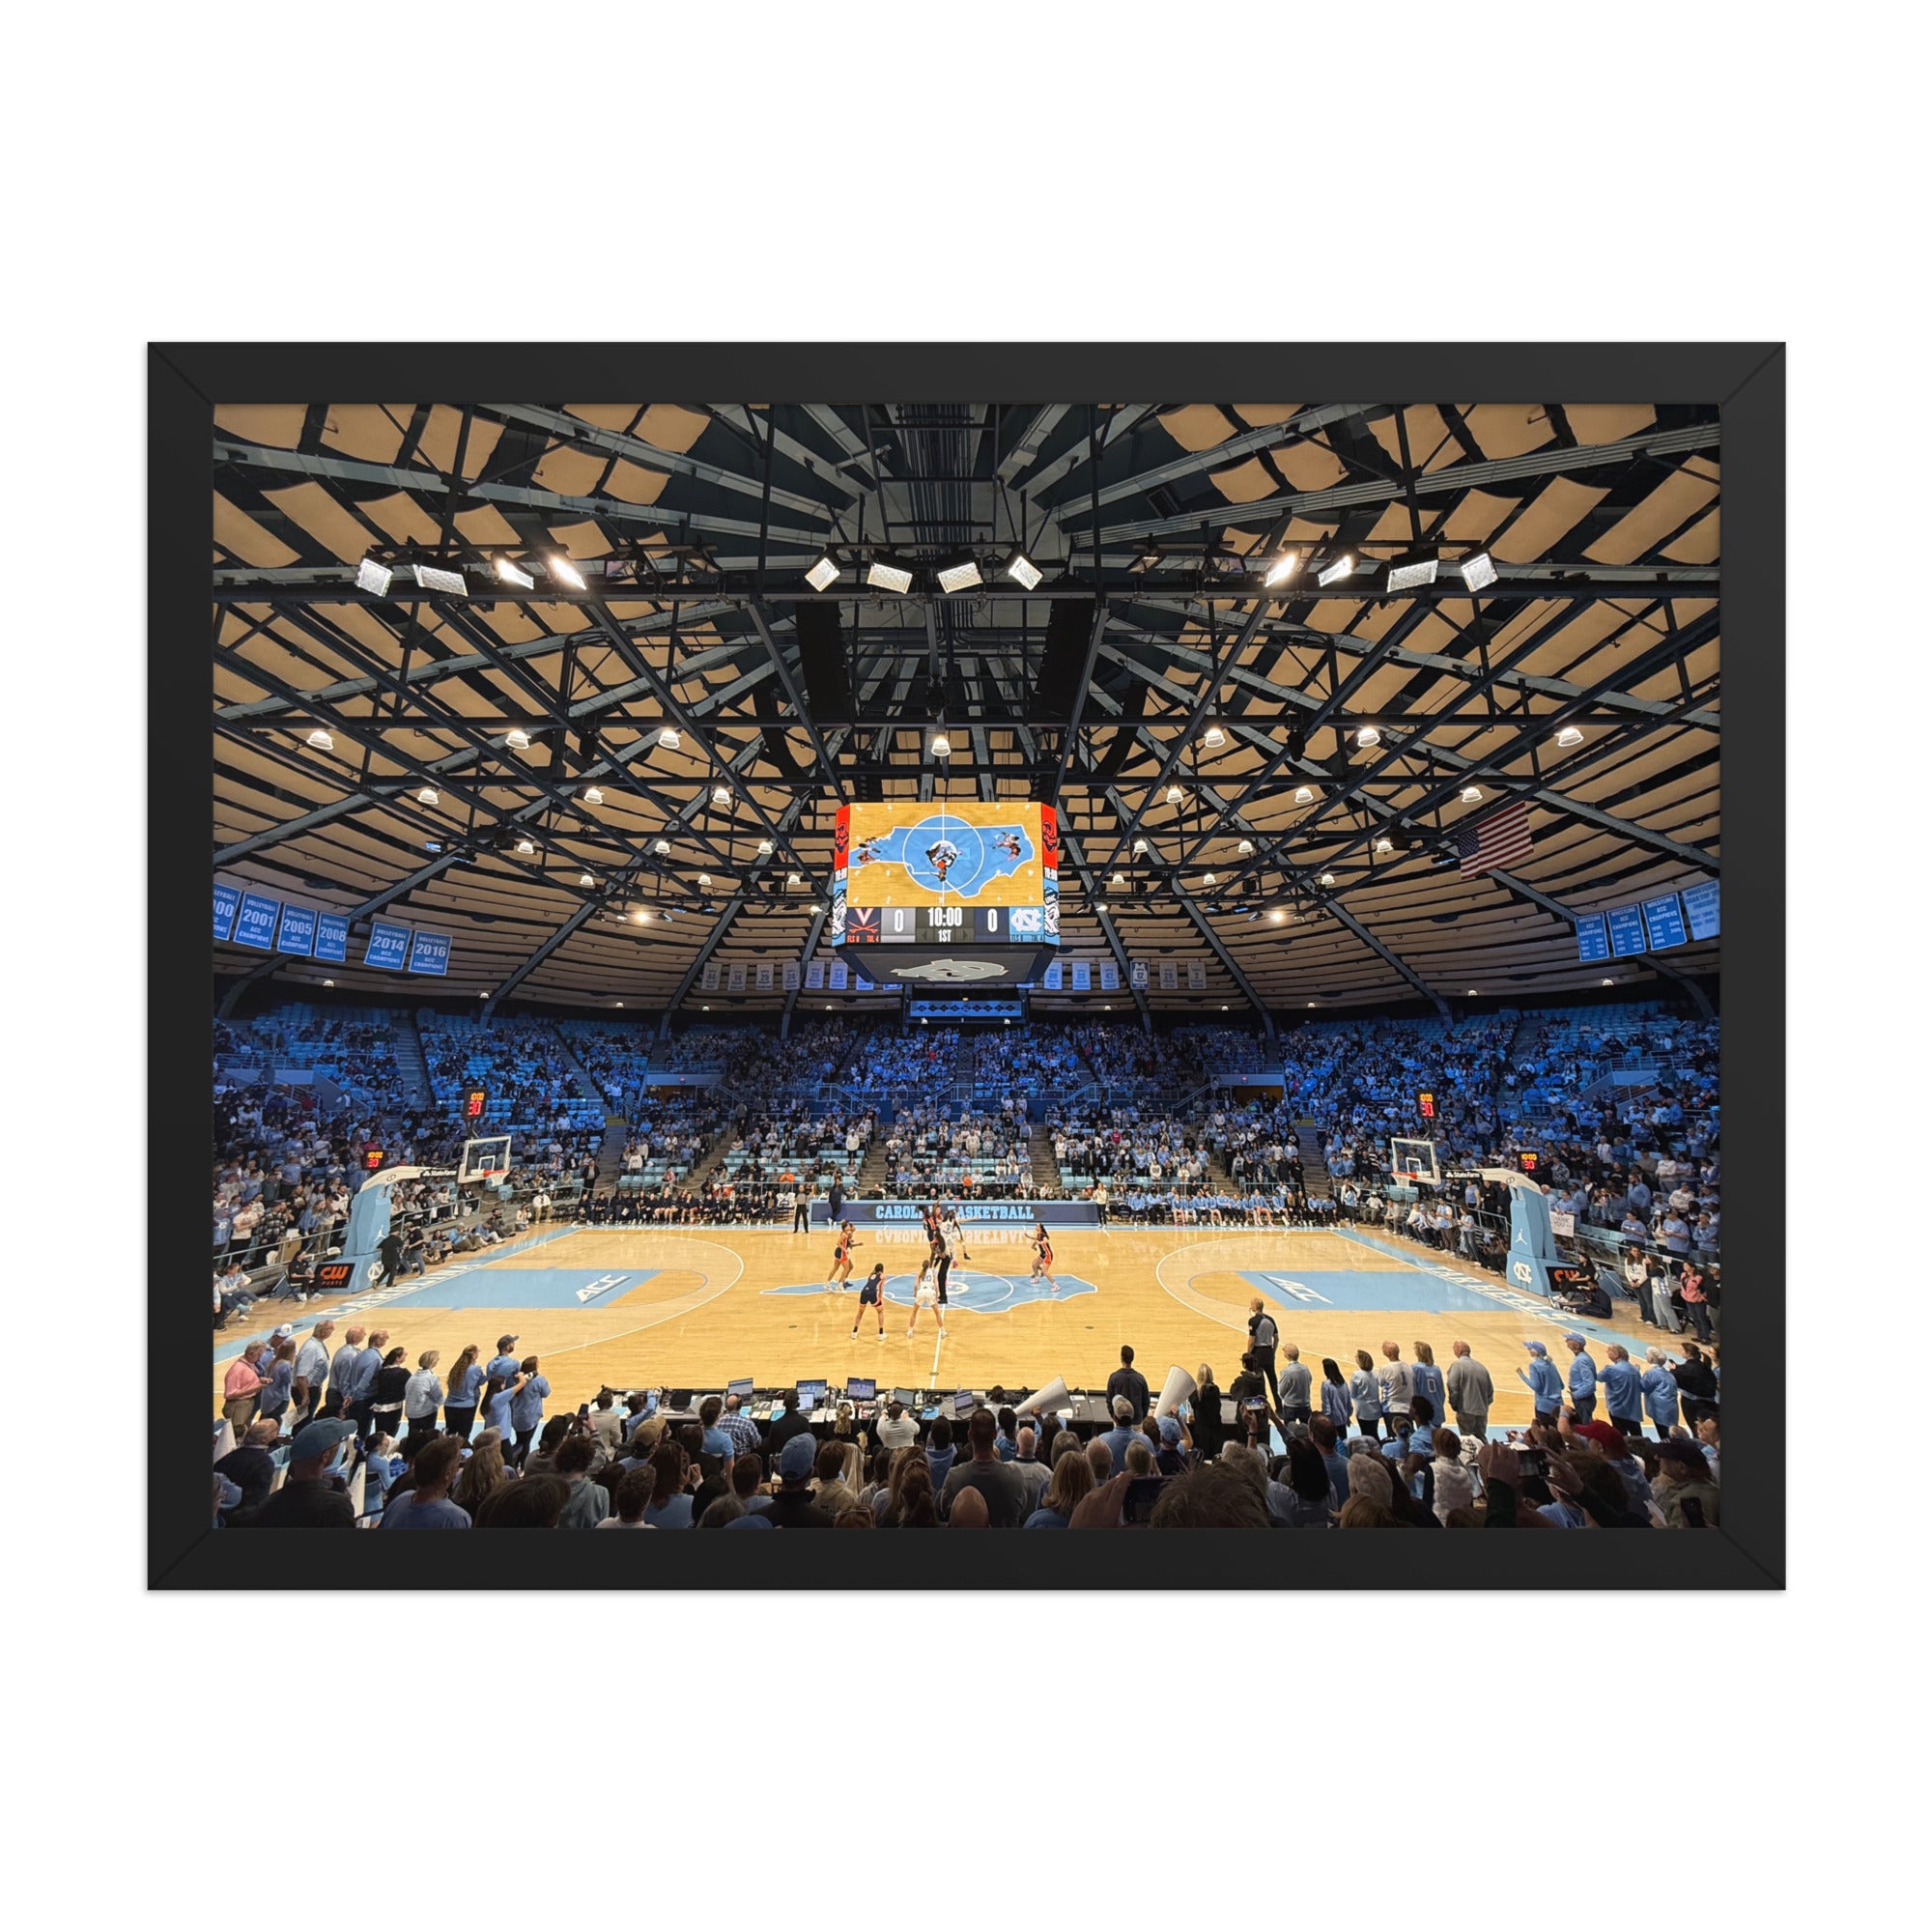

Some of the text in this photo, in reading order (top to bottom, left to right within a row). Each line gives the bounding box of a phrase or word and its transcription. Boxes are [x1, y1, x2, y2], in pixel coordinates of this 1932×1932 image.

[242, 909, 273, 927] 2001
[895, 909, 904, 933] 0
[927, 907, 963, 927] 10:00
[987, 908, 998, 932] 0
[284, 919, 312, 935] 2005
[320, 926, 347, 942] 2008
[372, 936, 405, 952] 2014
[938, 929, 952, 943] 1ST
[415, 943, 447, 957] 2016
[468, 1101, 482, 1116] 30
[1421, 1101, 1434, 1117] 30
[368, 1158, 379, 1168] 30
[1523, 1160, 1535, 1170] 30
[320, 1265, 350, 1281] CW
[576, 1274, 628, 1303] ACC
[1264, 1275, 1334, 1306] ACC
[1465, 1284, 1580, 1321] HEELS
[1427, 1378, 1437, 1393] 0
